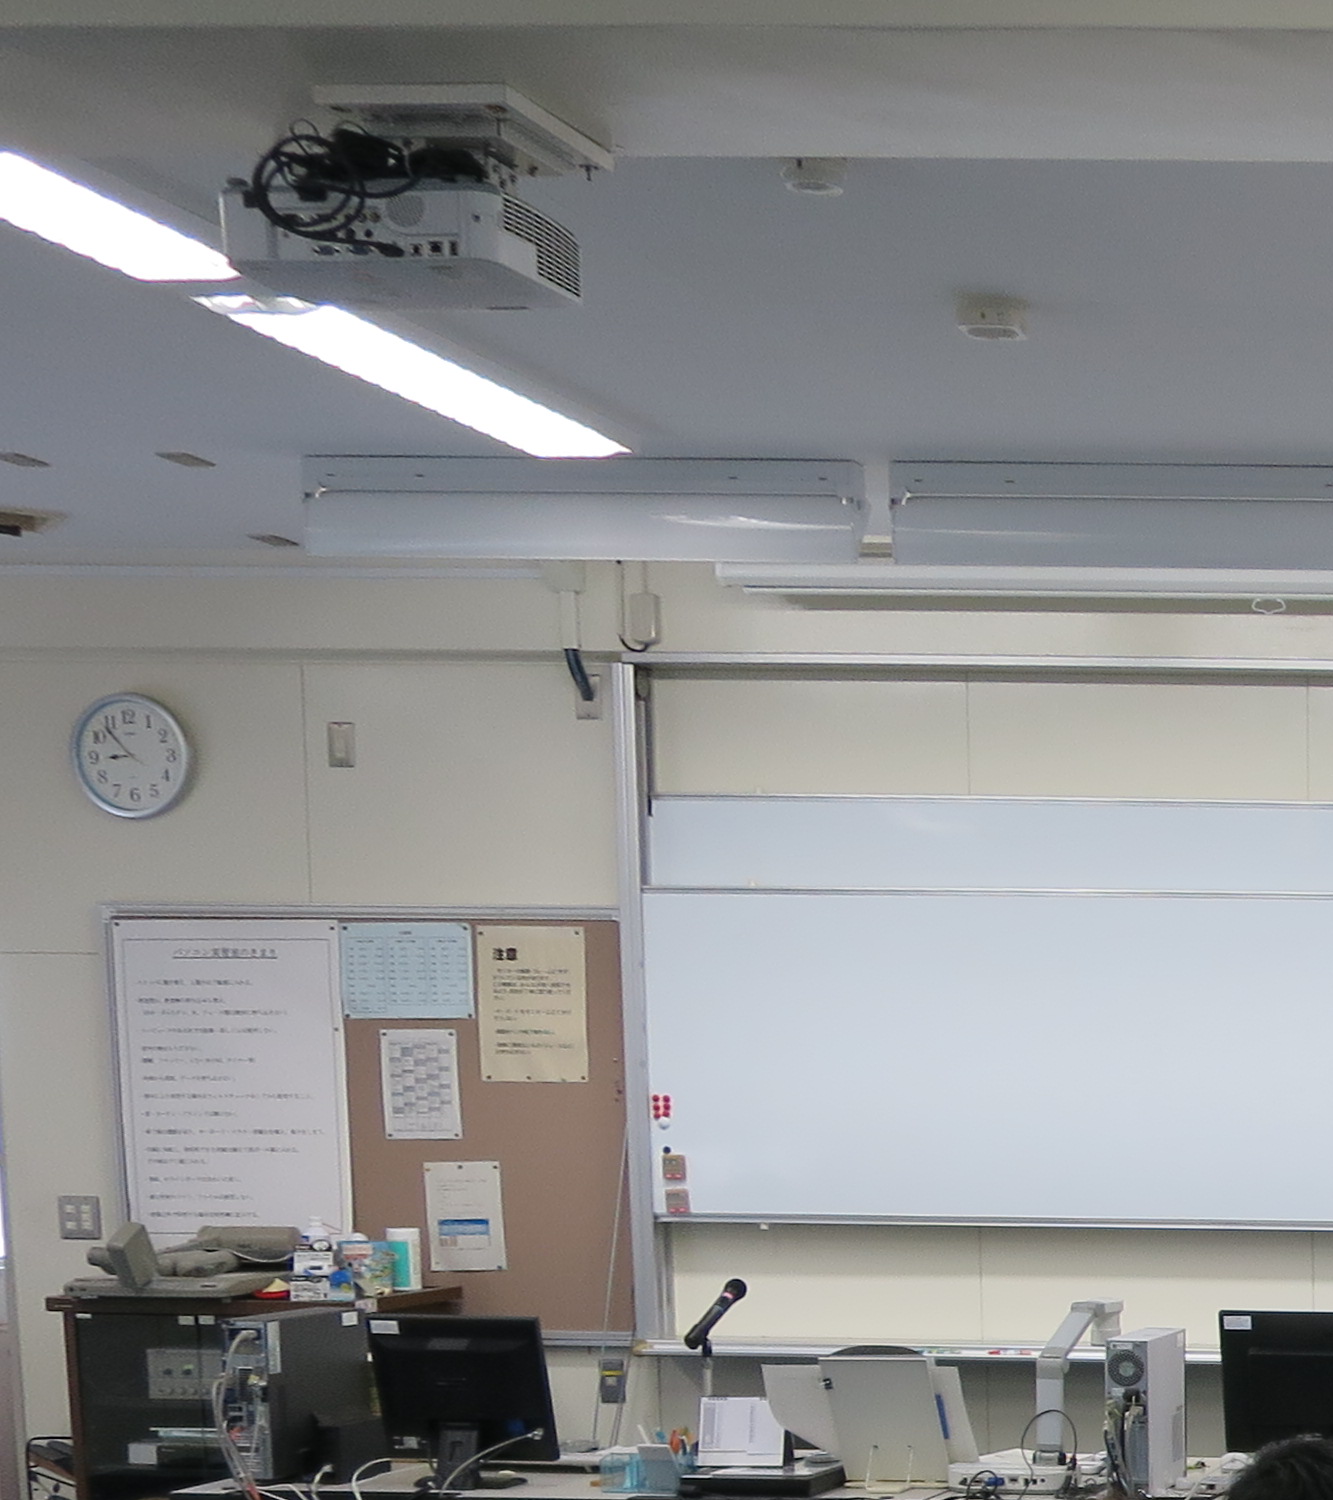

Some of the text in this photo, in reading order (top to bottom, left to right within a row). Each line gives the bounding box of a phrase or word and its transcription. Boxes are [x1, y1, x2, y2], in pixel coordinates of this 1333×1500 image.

[121, 708, 136, 725] 12
[145, 714, 153, 729] 1
[92, 729, 107, 745] 10
[157, 728, 168, 744] 2
[88, 749, 100, 765] 9
[165, 747, 177, 763] 3
[97, 769, 109, 784] 8
[161, 768, 171, 782] 4
[112, 783, 122, 798] 7
[129, 787, 142, 802] 6
[149, 783, 160, 798] 5
[492, 947, 518, 961] 注意
